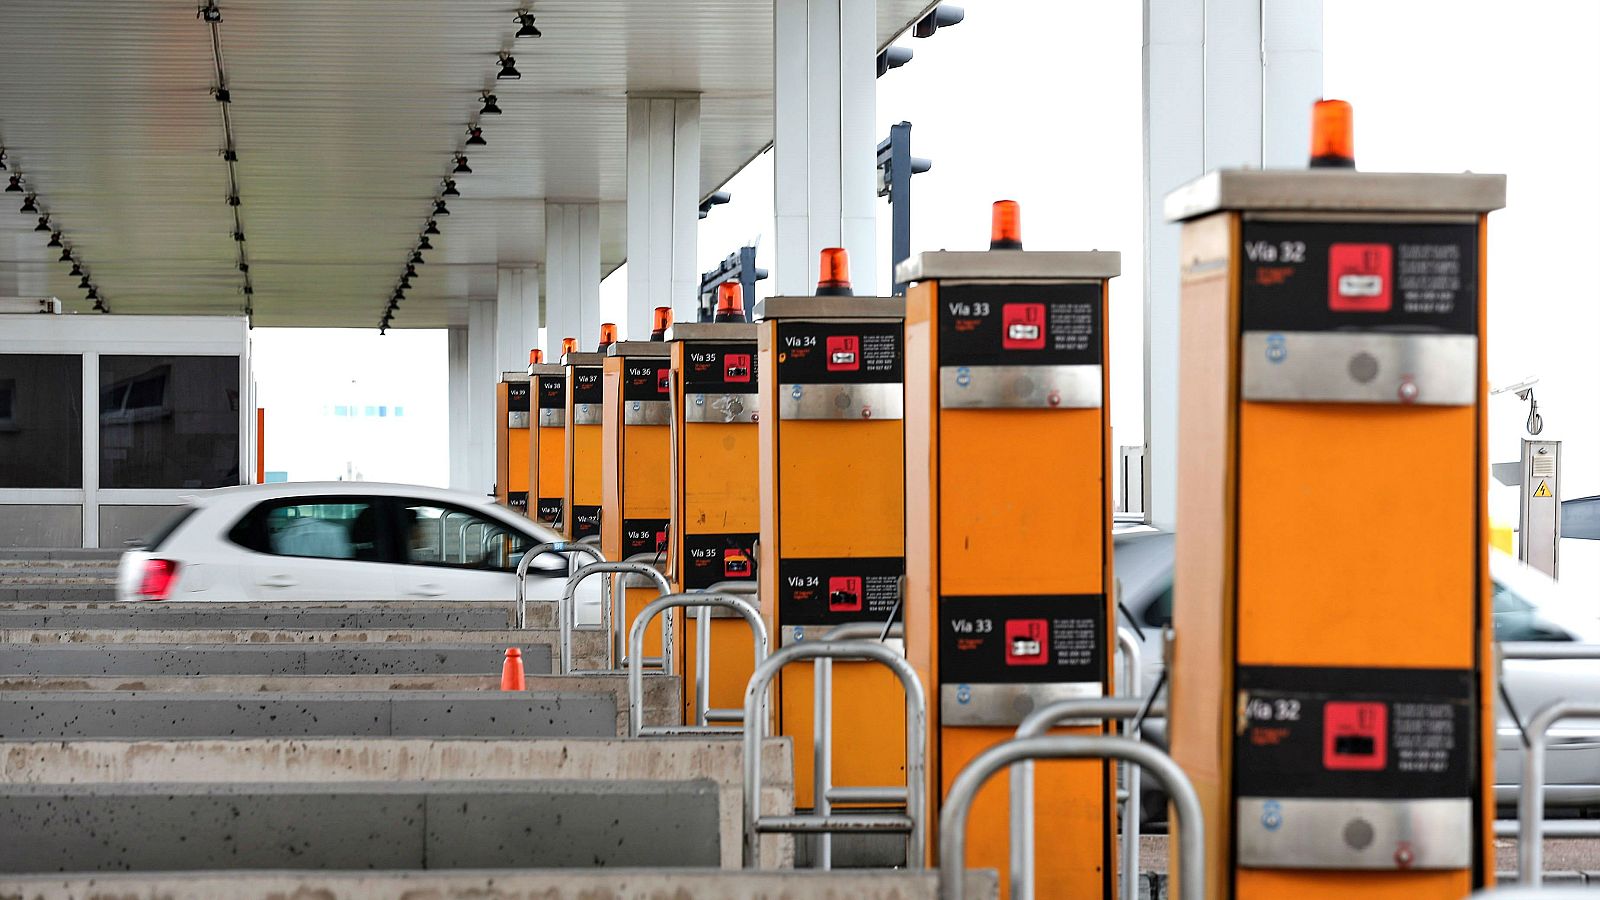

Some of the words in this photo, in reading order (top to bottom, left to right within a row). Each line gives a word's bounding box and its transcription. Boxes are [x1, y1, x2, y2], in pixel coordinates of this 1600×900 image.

[1279, 240, 1307, 263] 32
[973, 302, 990, 316] 33
[803, 336, 817, 347] 34
[705, 352, 717, 362] 35
[640, 367, 651, 376] 36
[589, 375, 598, 383] 37
[640, 531, 650, 540] 36
[705, 548, 717, 558] 35
[805, 576, 819, 587] 34
[975, 619, 993, 633] 33
[1274, 698, 1302, 721] 32
